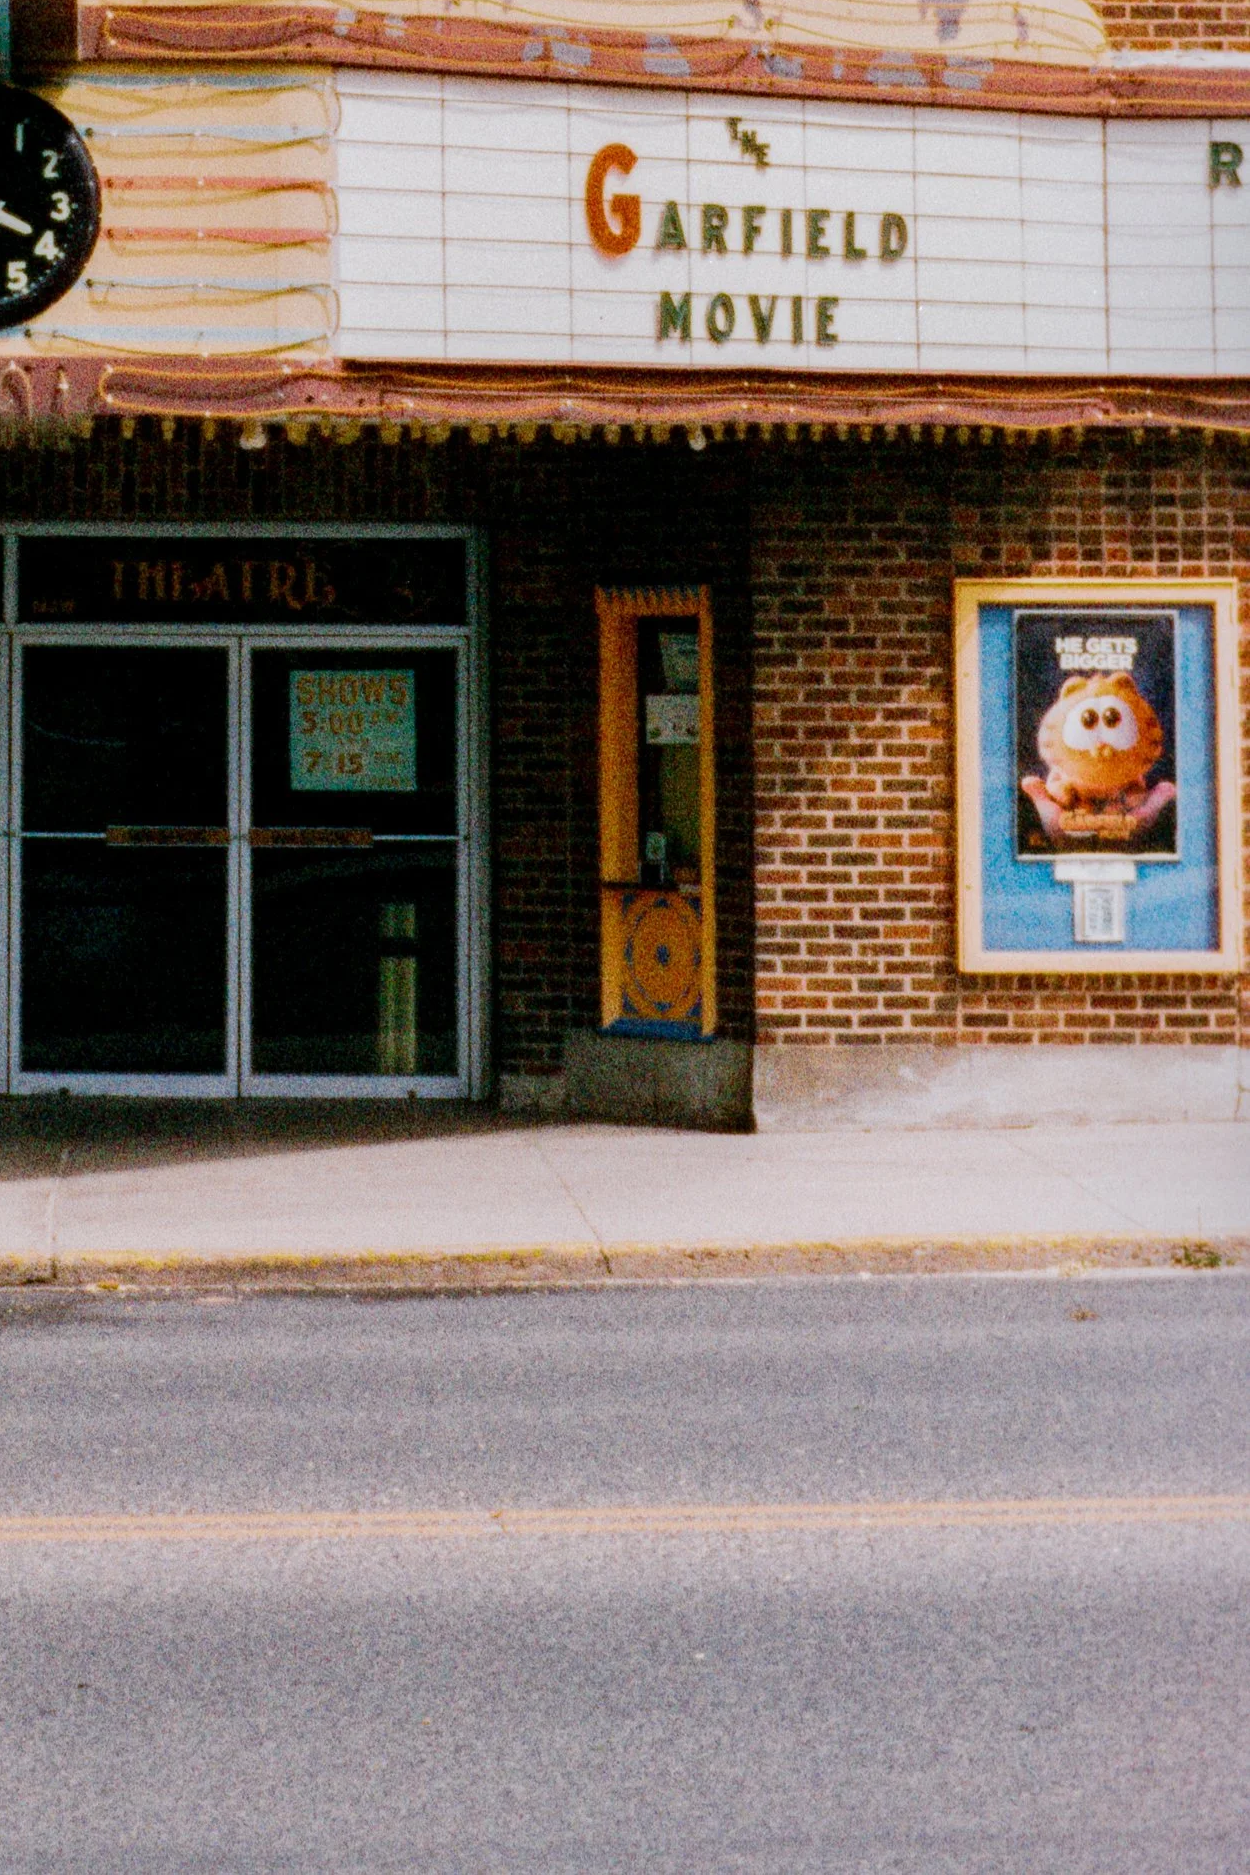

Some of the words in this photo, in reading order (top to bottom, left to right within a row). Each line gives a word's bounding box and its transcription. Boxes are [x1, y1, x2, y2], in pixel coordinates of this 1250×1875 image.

[15, 124, 25, 152] 1
[725, 117, 770, 167] THE
[42, 150, 59, 179] 2
[1209, 141, 1243, 188] R
[51, 192, 71, 221] 3
[585, 143, 908, 262] GARFIELD
[34, 231, 59, 260] 4
[7, 261, 28, 291] 5
[656, 291, 839, 347] MOVIE
[1055, 637, 1083, 654] HE
[1086, 637, 1137, 654] GETS
[1060, 654, 1133, 671] BIGGER
[297, 676, 407, 705] SHOWS
